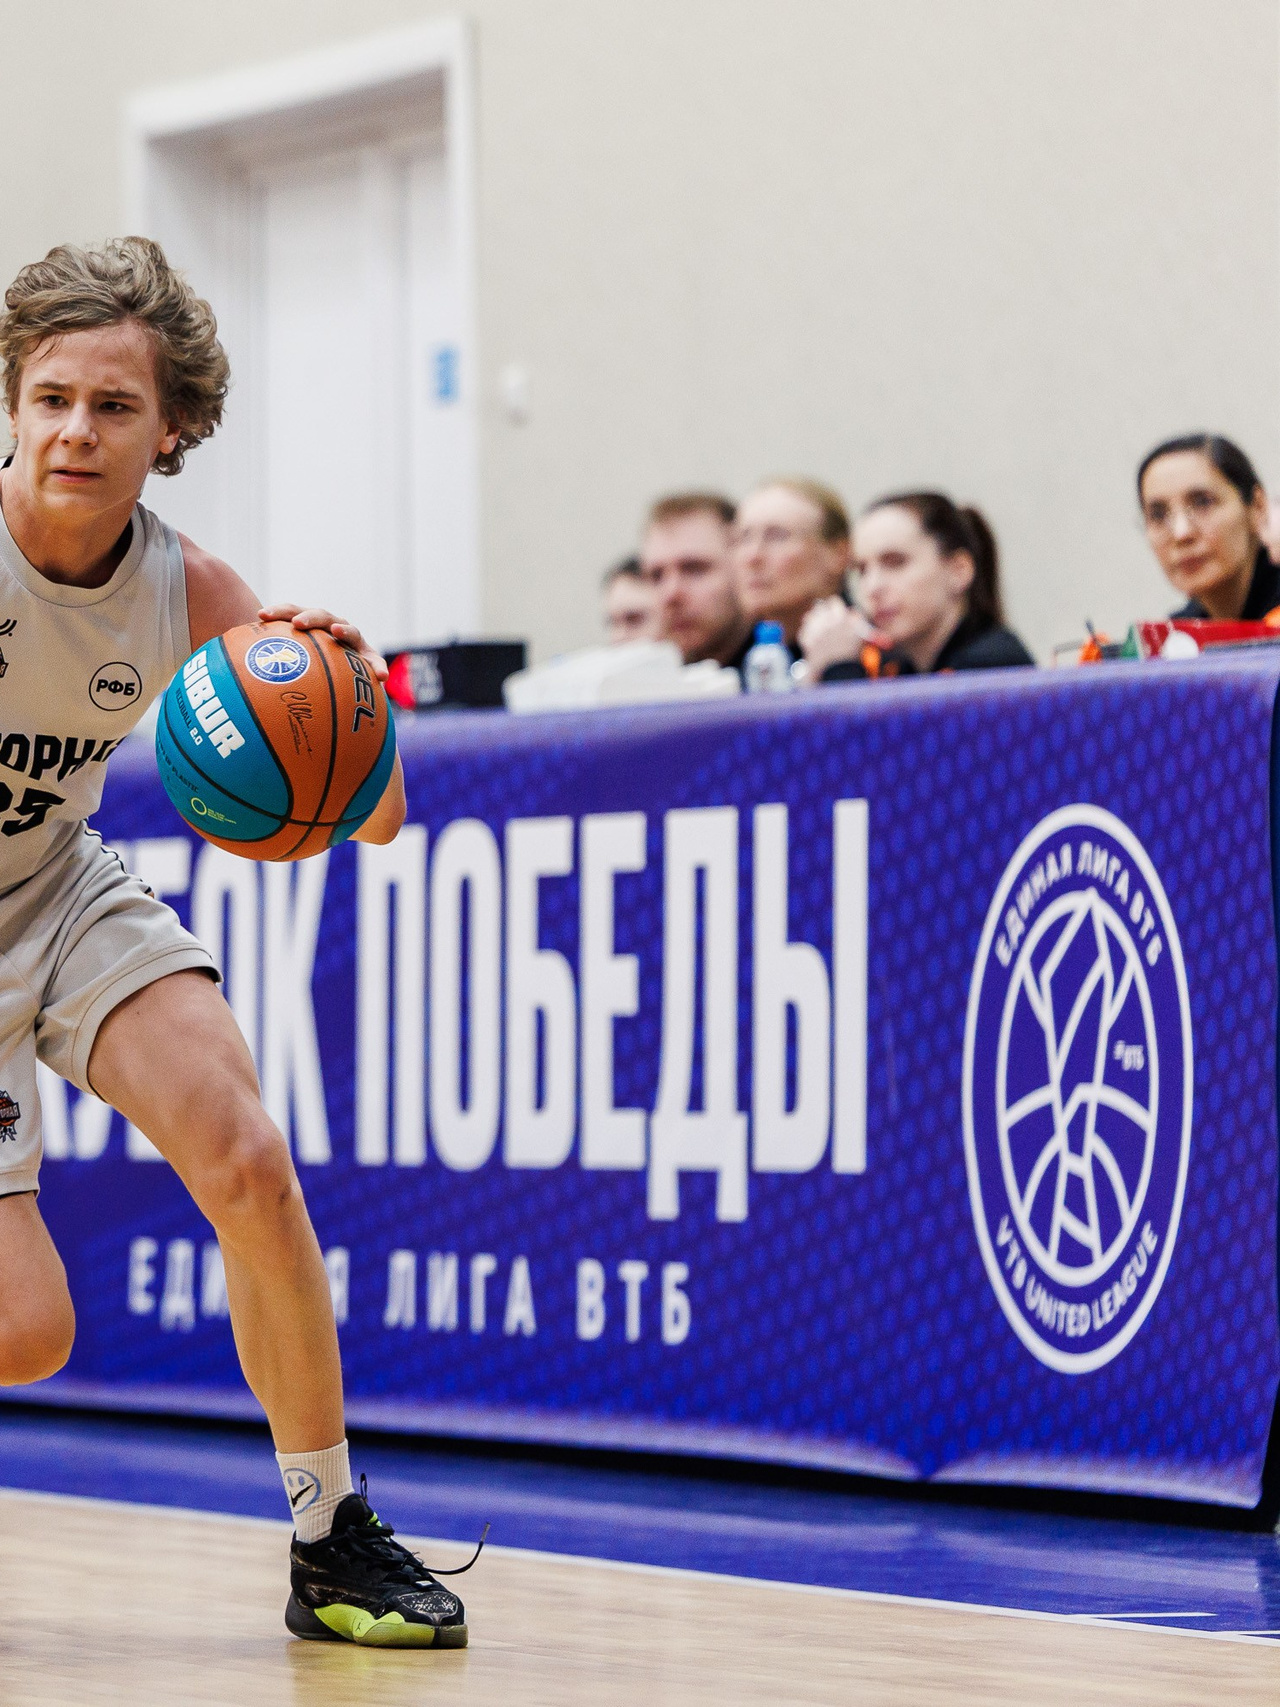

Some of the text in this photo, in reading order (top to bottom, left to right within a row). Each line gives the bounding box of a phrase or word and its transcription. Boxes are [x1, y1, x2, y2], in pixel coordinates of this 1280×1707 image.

[95, 678, 136, 697] РФБ
[183, 650, 246, 760] SIBUR
[189, 726, 203, 746] 2.0
[994, 840, 1163, 968] ЕДИНАЯ ЛИГА ВТБ
[354, 797, 869, 1223] ПОБЕДЫ
[127, 1235, 692, 1347] ЕДИЯ ЛИГА ВТБ
[996, 1214, 1159, 1338] VTB UNITED LEAGUE
